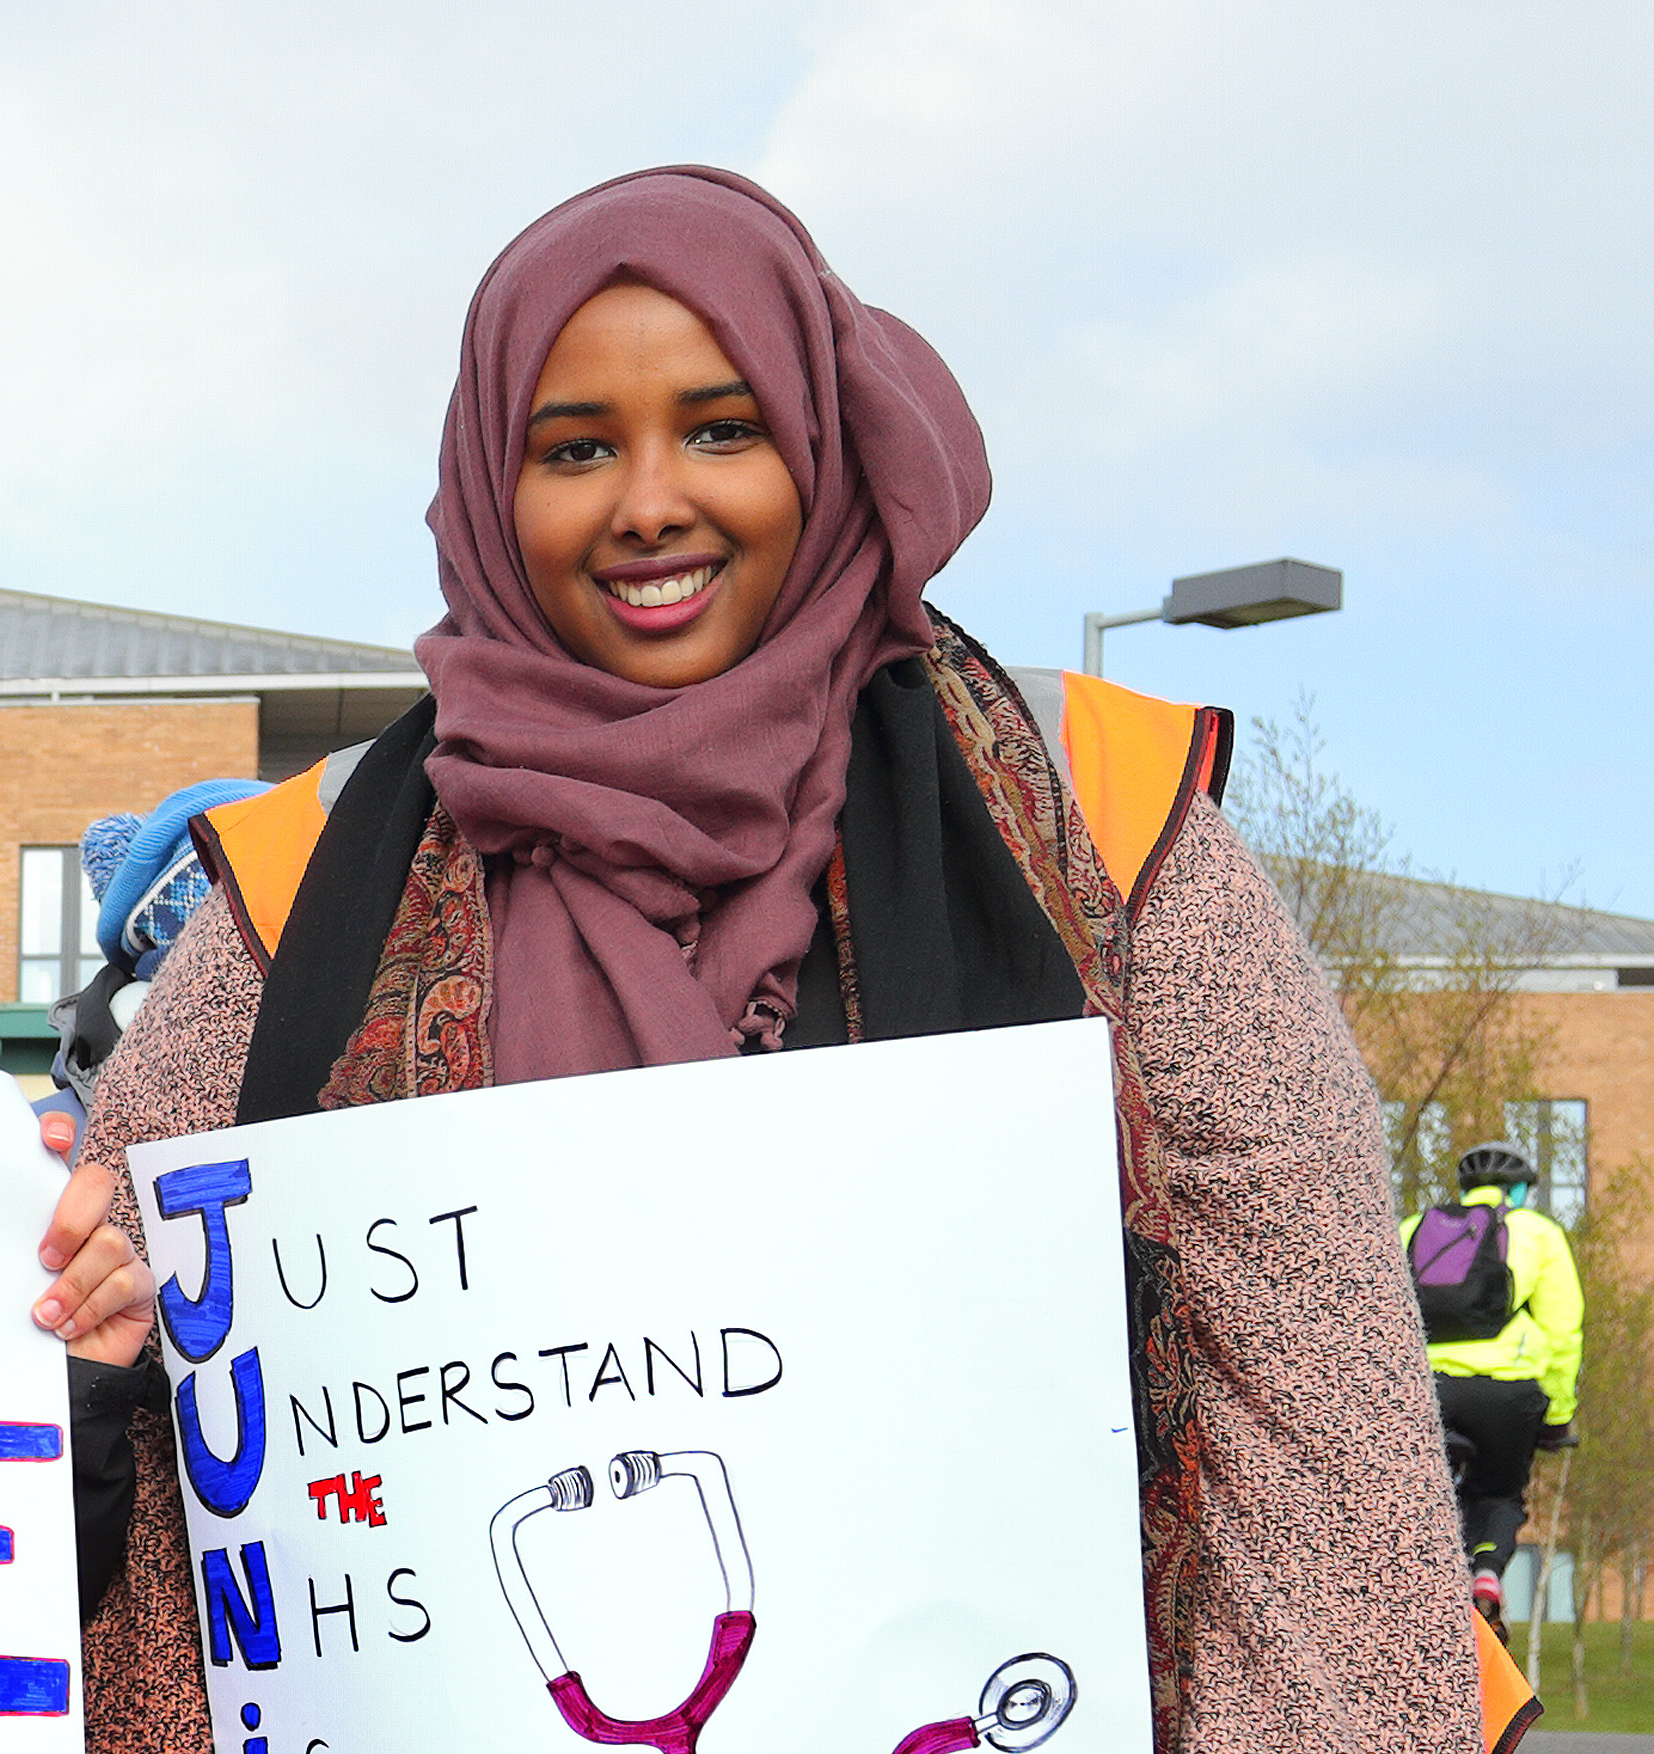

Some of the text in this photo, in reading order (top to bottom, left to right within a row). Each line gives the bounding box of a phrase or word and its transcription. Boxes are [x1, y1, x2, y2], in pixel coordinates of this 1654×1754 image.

[154, 1157, 478, 1363] JUST
[176, 1327, 783, 1519] UNDERSTAND
[307, 1471, 387, 1528] THE
[201, 1540, 432, 1670] NHS
